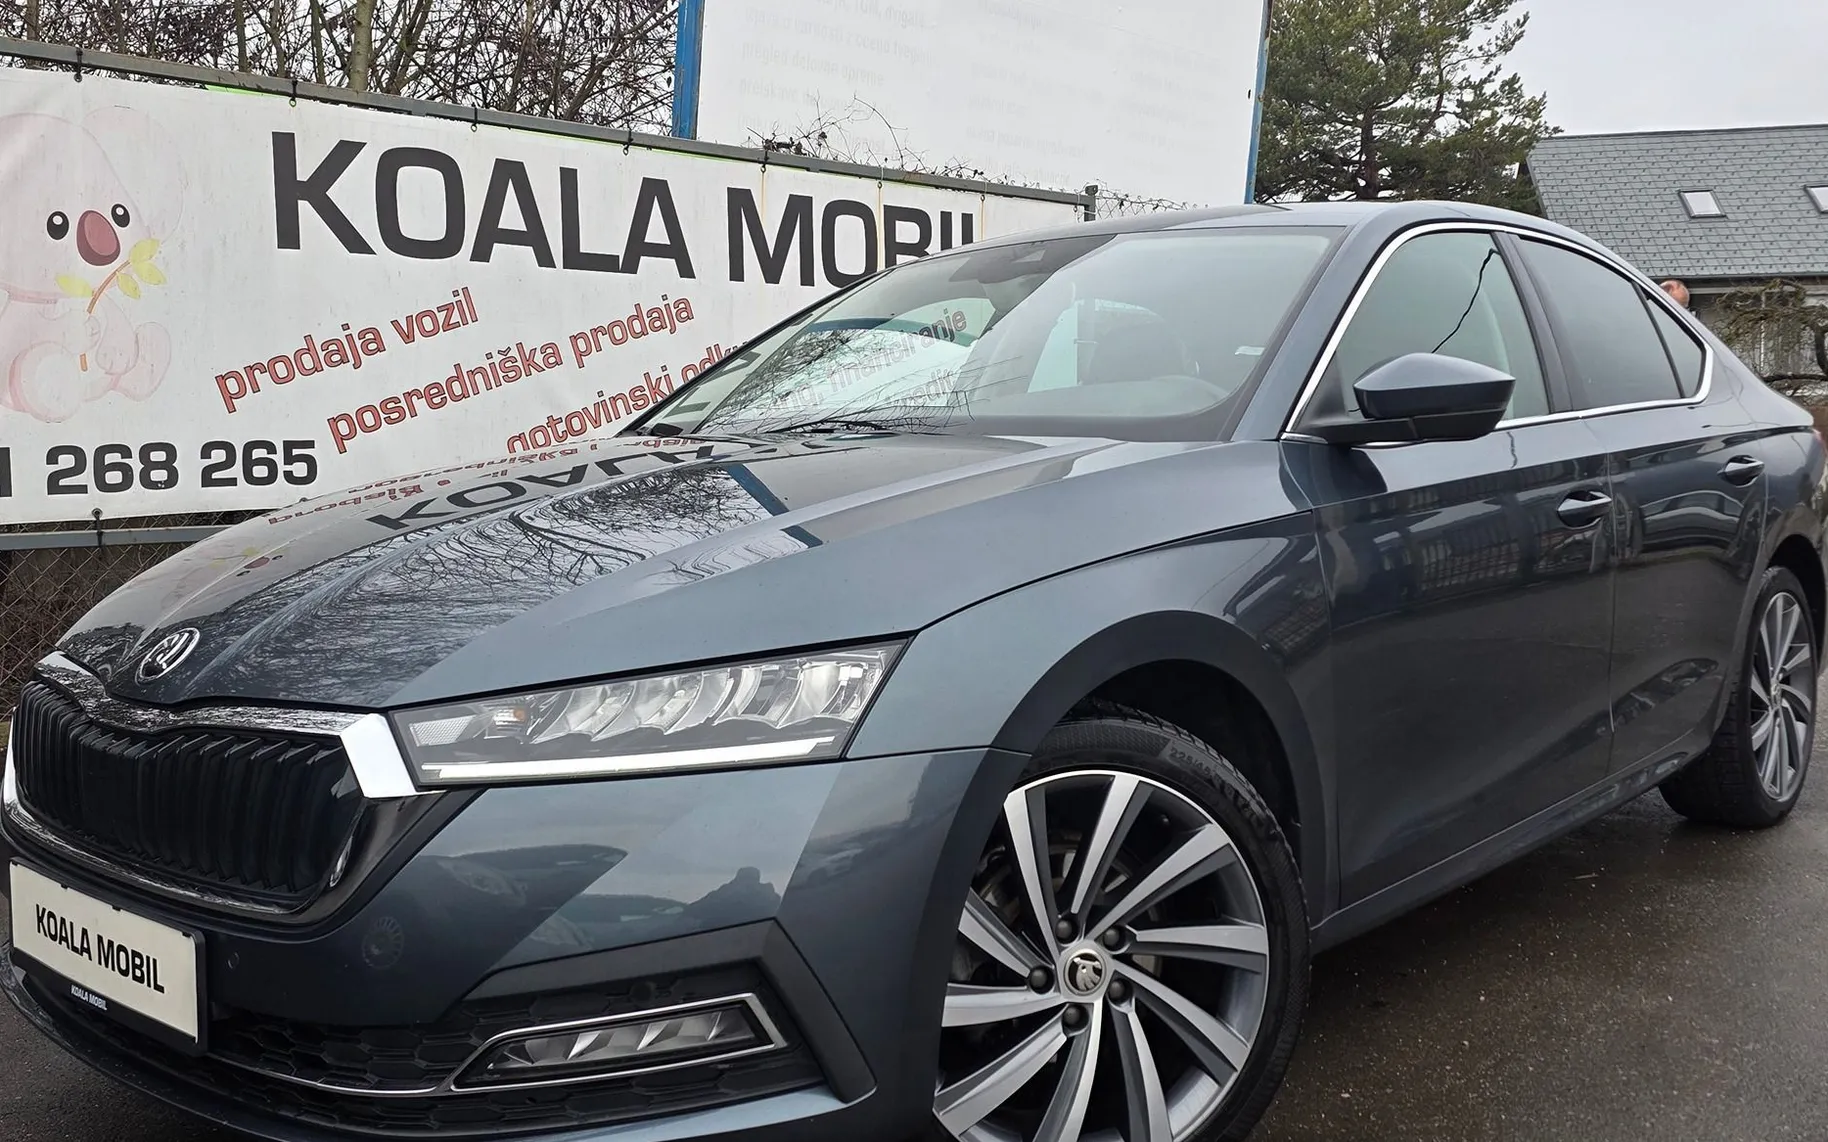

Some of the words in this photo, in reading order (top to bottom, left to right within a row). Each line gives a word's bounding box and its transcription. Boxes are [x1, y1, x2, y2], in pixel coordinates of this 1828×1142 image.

[271, 131, 696, 280] KOALA
[214, 323, 387, 414] prodaja
[390, 286, 479, 345] vozil
[326, 341, 563, 455] posredniška
[568, 294, 695, 369] prodaja
[45, 441, 180, 496] 268
[199, 439, 318, 488] 265
[35, 903, 93, 961] KOALA
[96, 933, 165, 994] MOBIL
[70, 984, 88, 1002] KOALA
[88, 992, 108, 1011] MOBIL
